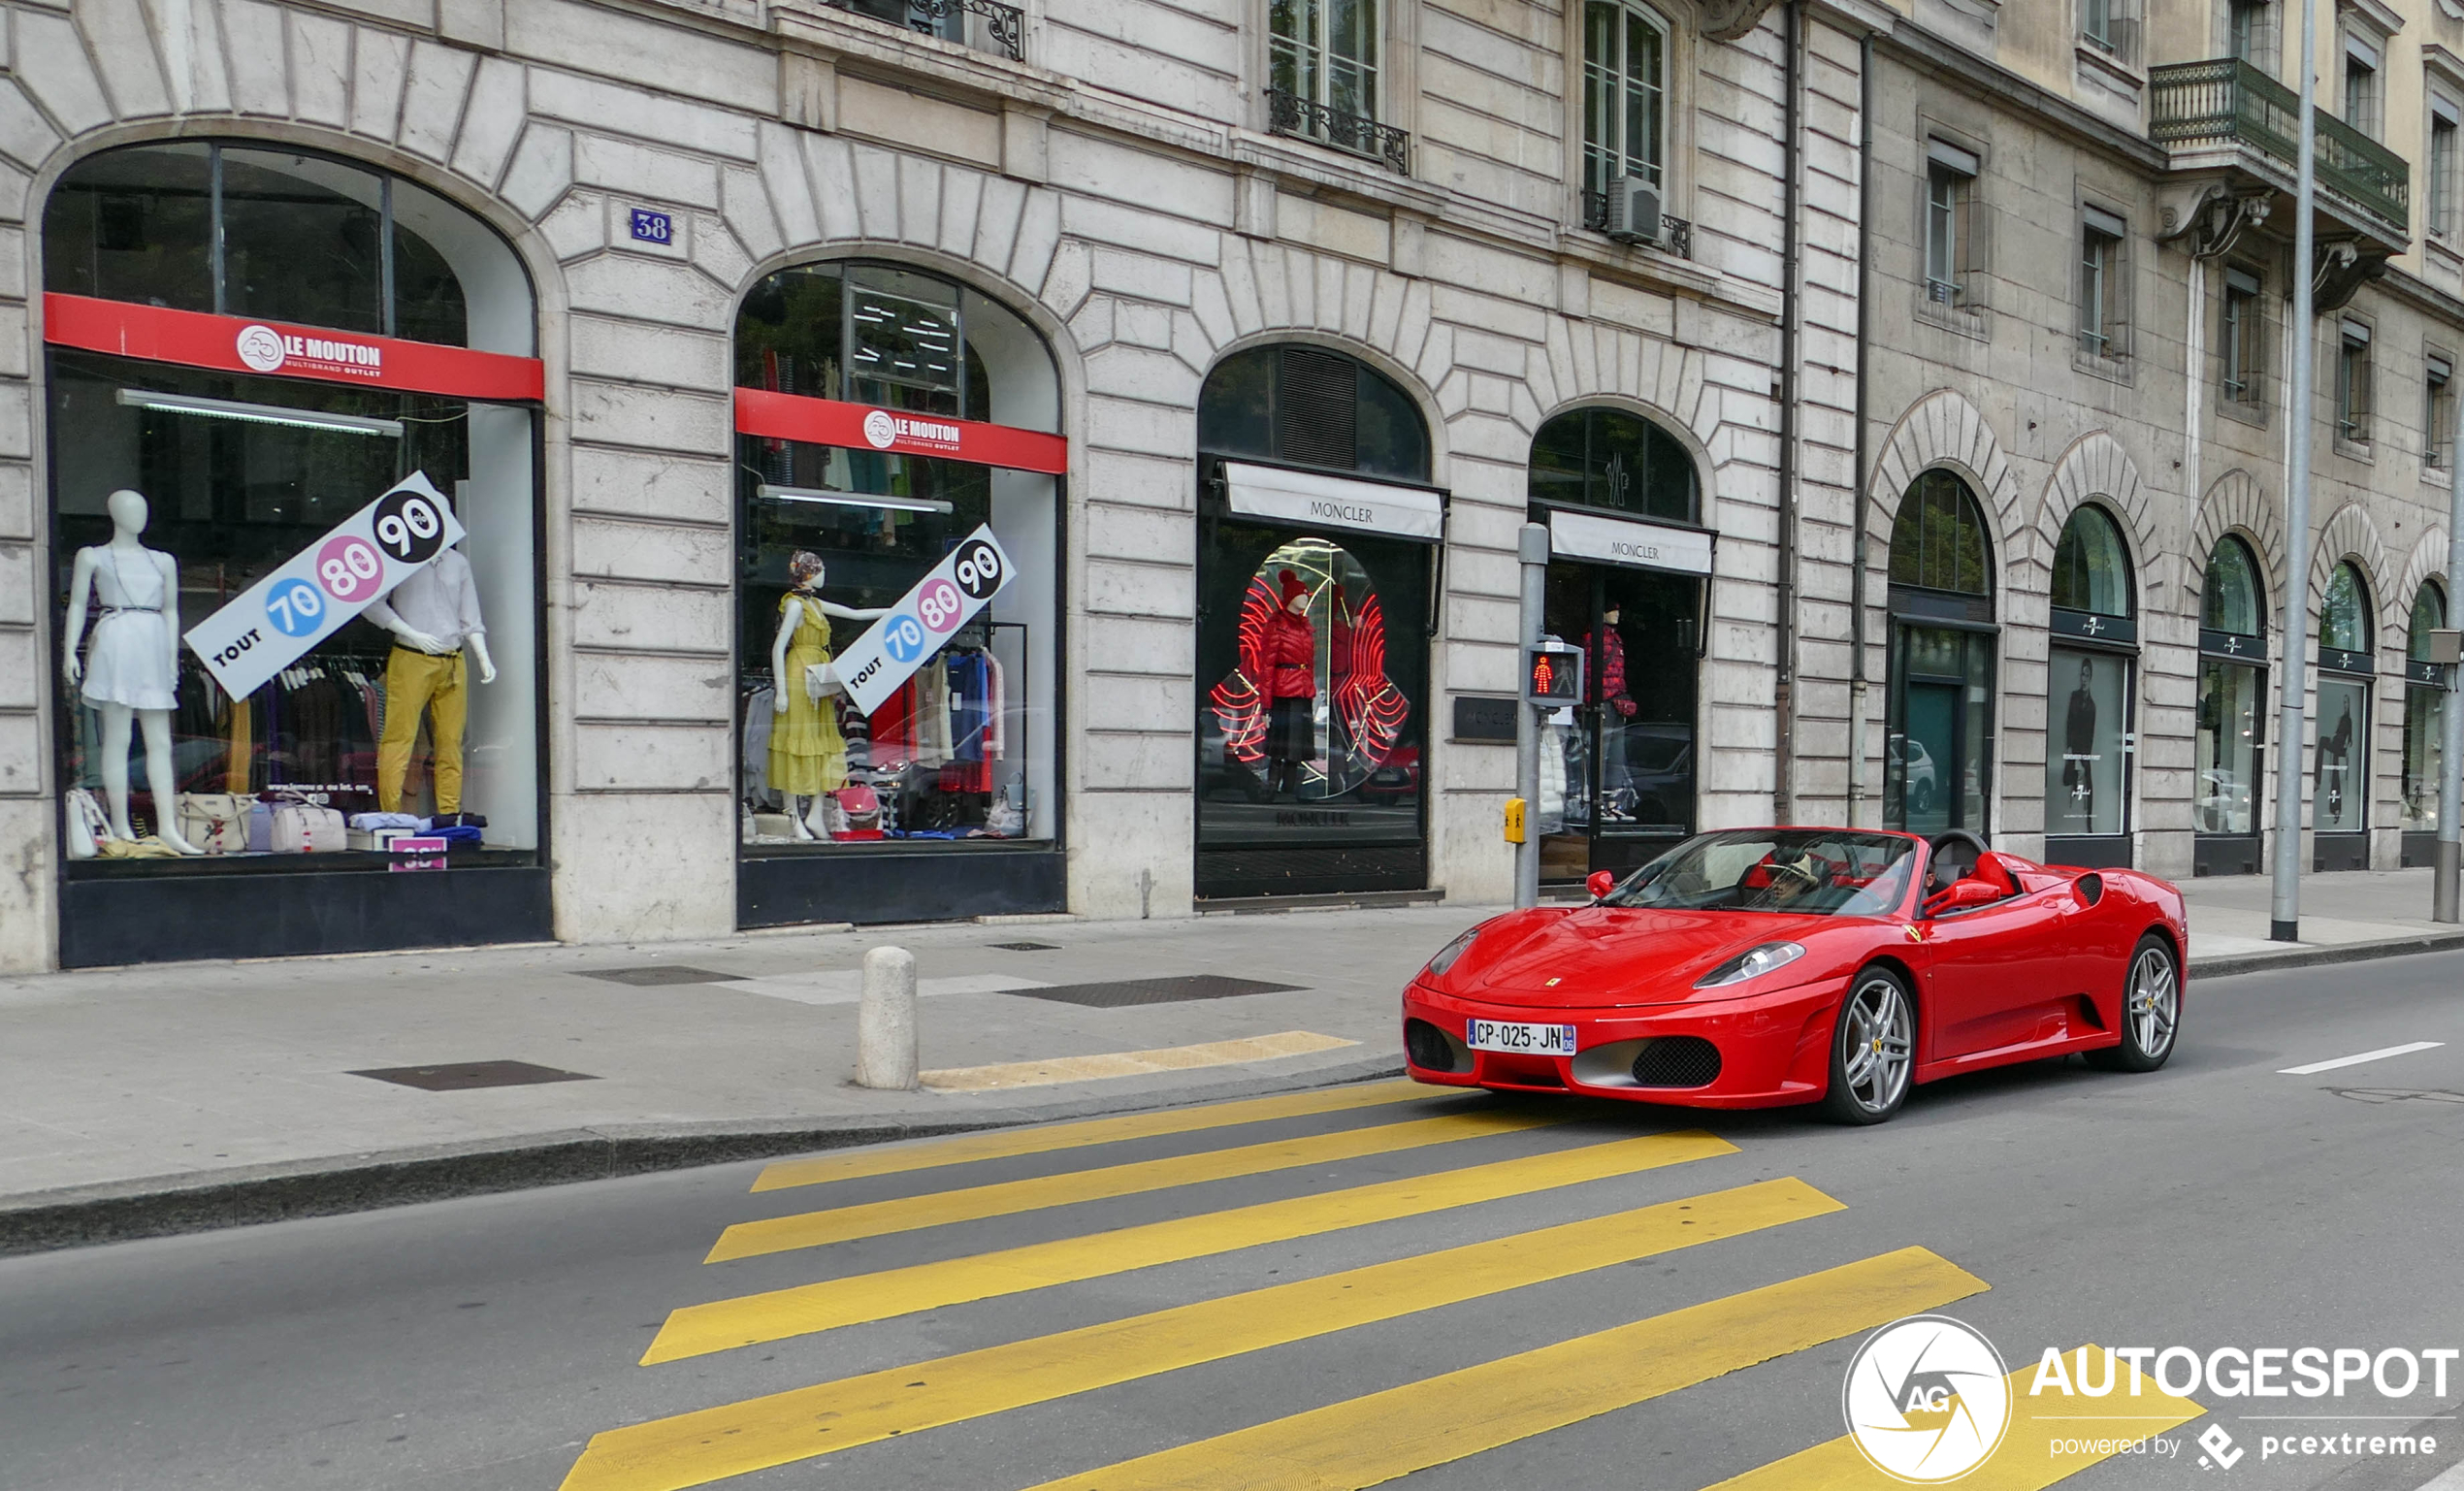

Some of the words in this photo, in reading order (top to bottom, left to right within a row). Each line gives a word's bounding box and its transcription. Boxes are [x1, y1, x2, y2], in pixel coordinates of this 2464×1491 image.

[637, 213, 667, 240] 38
[283, 336, 304, 356] LE
[306, 339, 380, 367] MOUTON
[285, 360, 341, 373] MULTIBRAND
[343, 367, 380, 377] OUTLET
[894, 418, 908, 436] LE
[910, 420, 959, 442] MOUTON
[1311, 502, 1373, 523] MONCLER
[1611, 542, 1659, 560] MONCLER
[212, 628, 262, 667] TOUT
[850, 657, 883, 689] TOUT
[1477, 1022, 1561, 1049] CP-025-JN
[1564, 1039, 1574, 1051] 06
